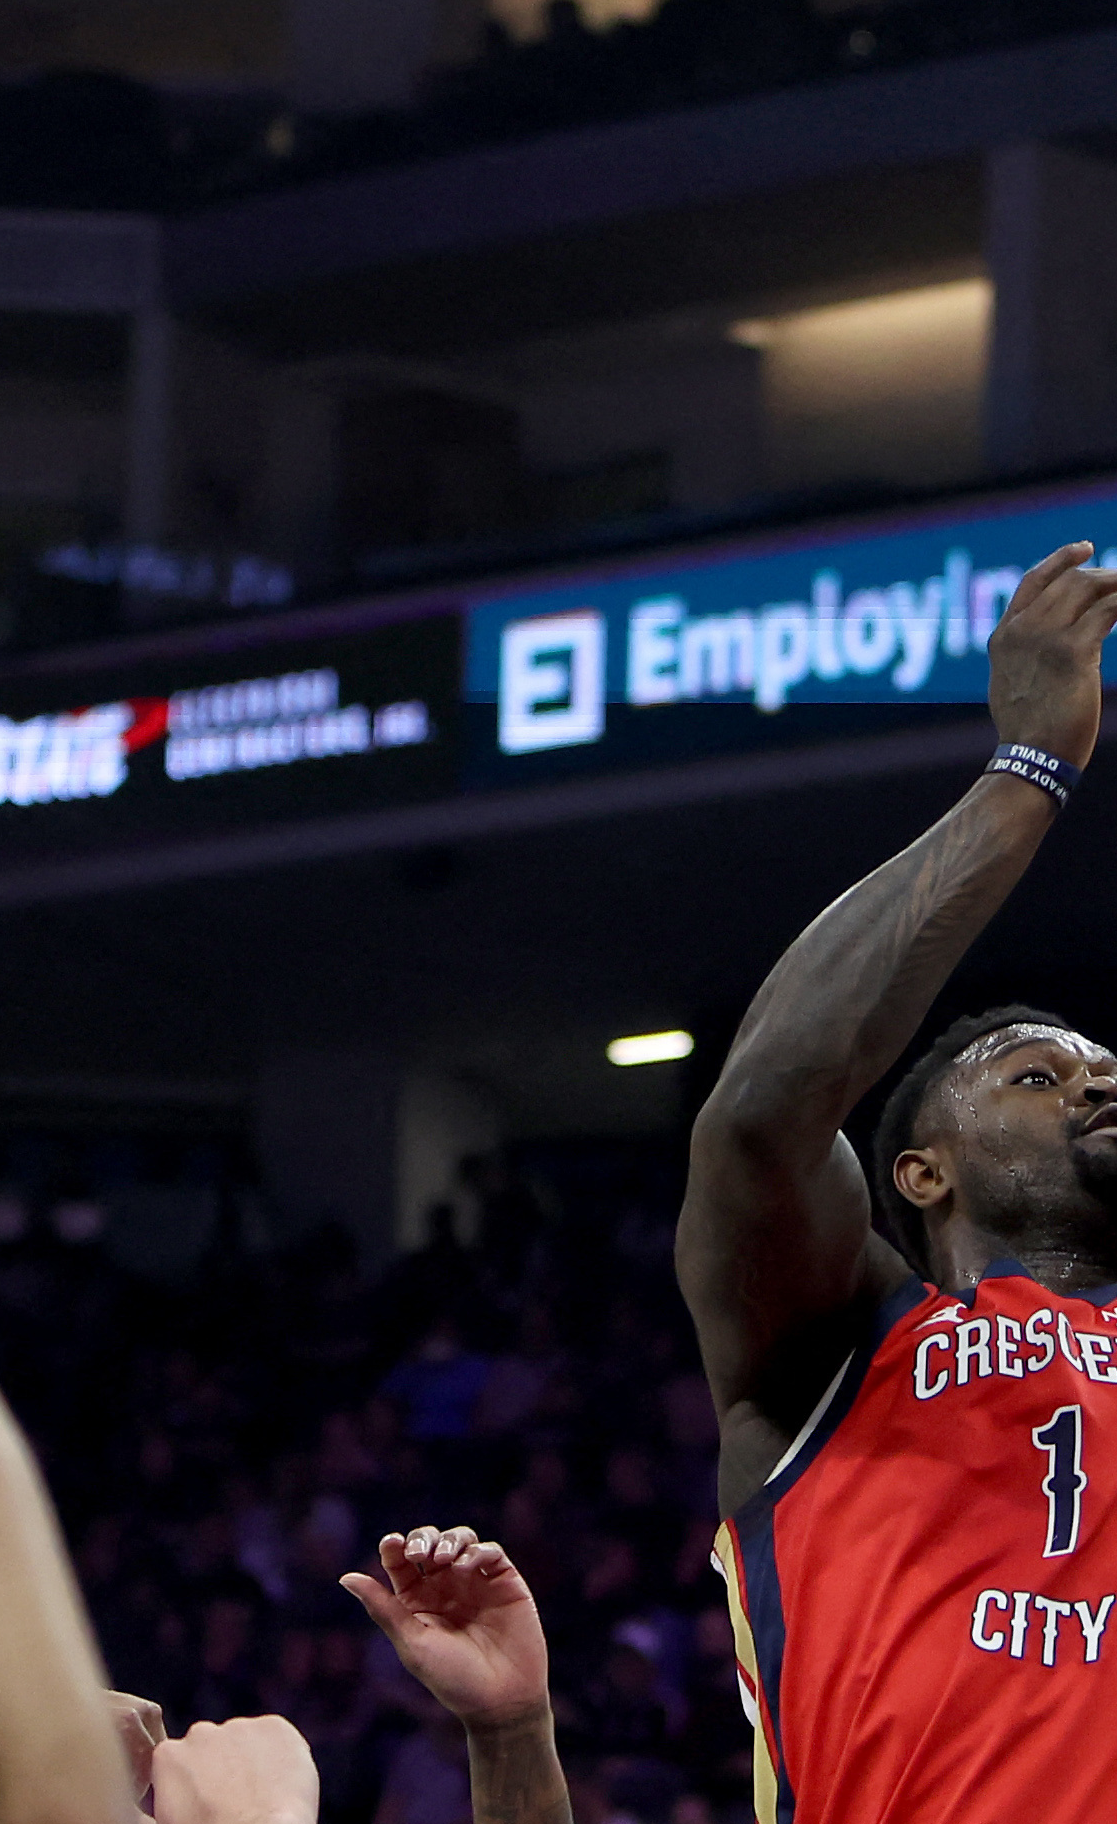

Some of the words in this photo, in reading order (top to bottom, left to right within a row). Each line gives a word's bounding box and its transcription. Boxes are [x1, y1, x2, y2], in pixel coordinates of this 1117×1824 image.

[1010, 744, 1060, 771] D'EVILS
[1011, 761, 1029, 776] TO
[1032, 1404, 1088, 1558] 1
[970, 1588, 1117, 1668] CITY
